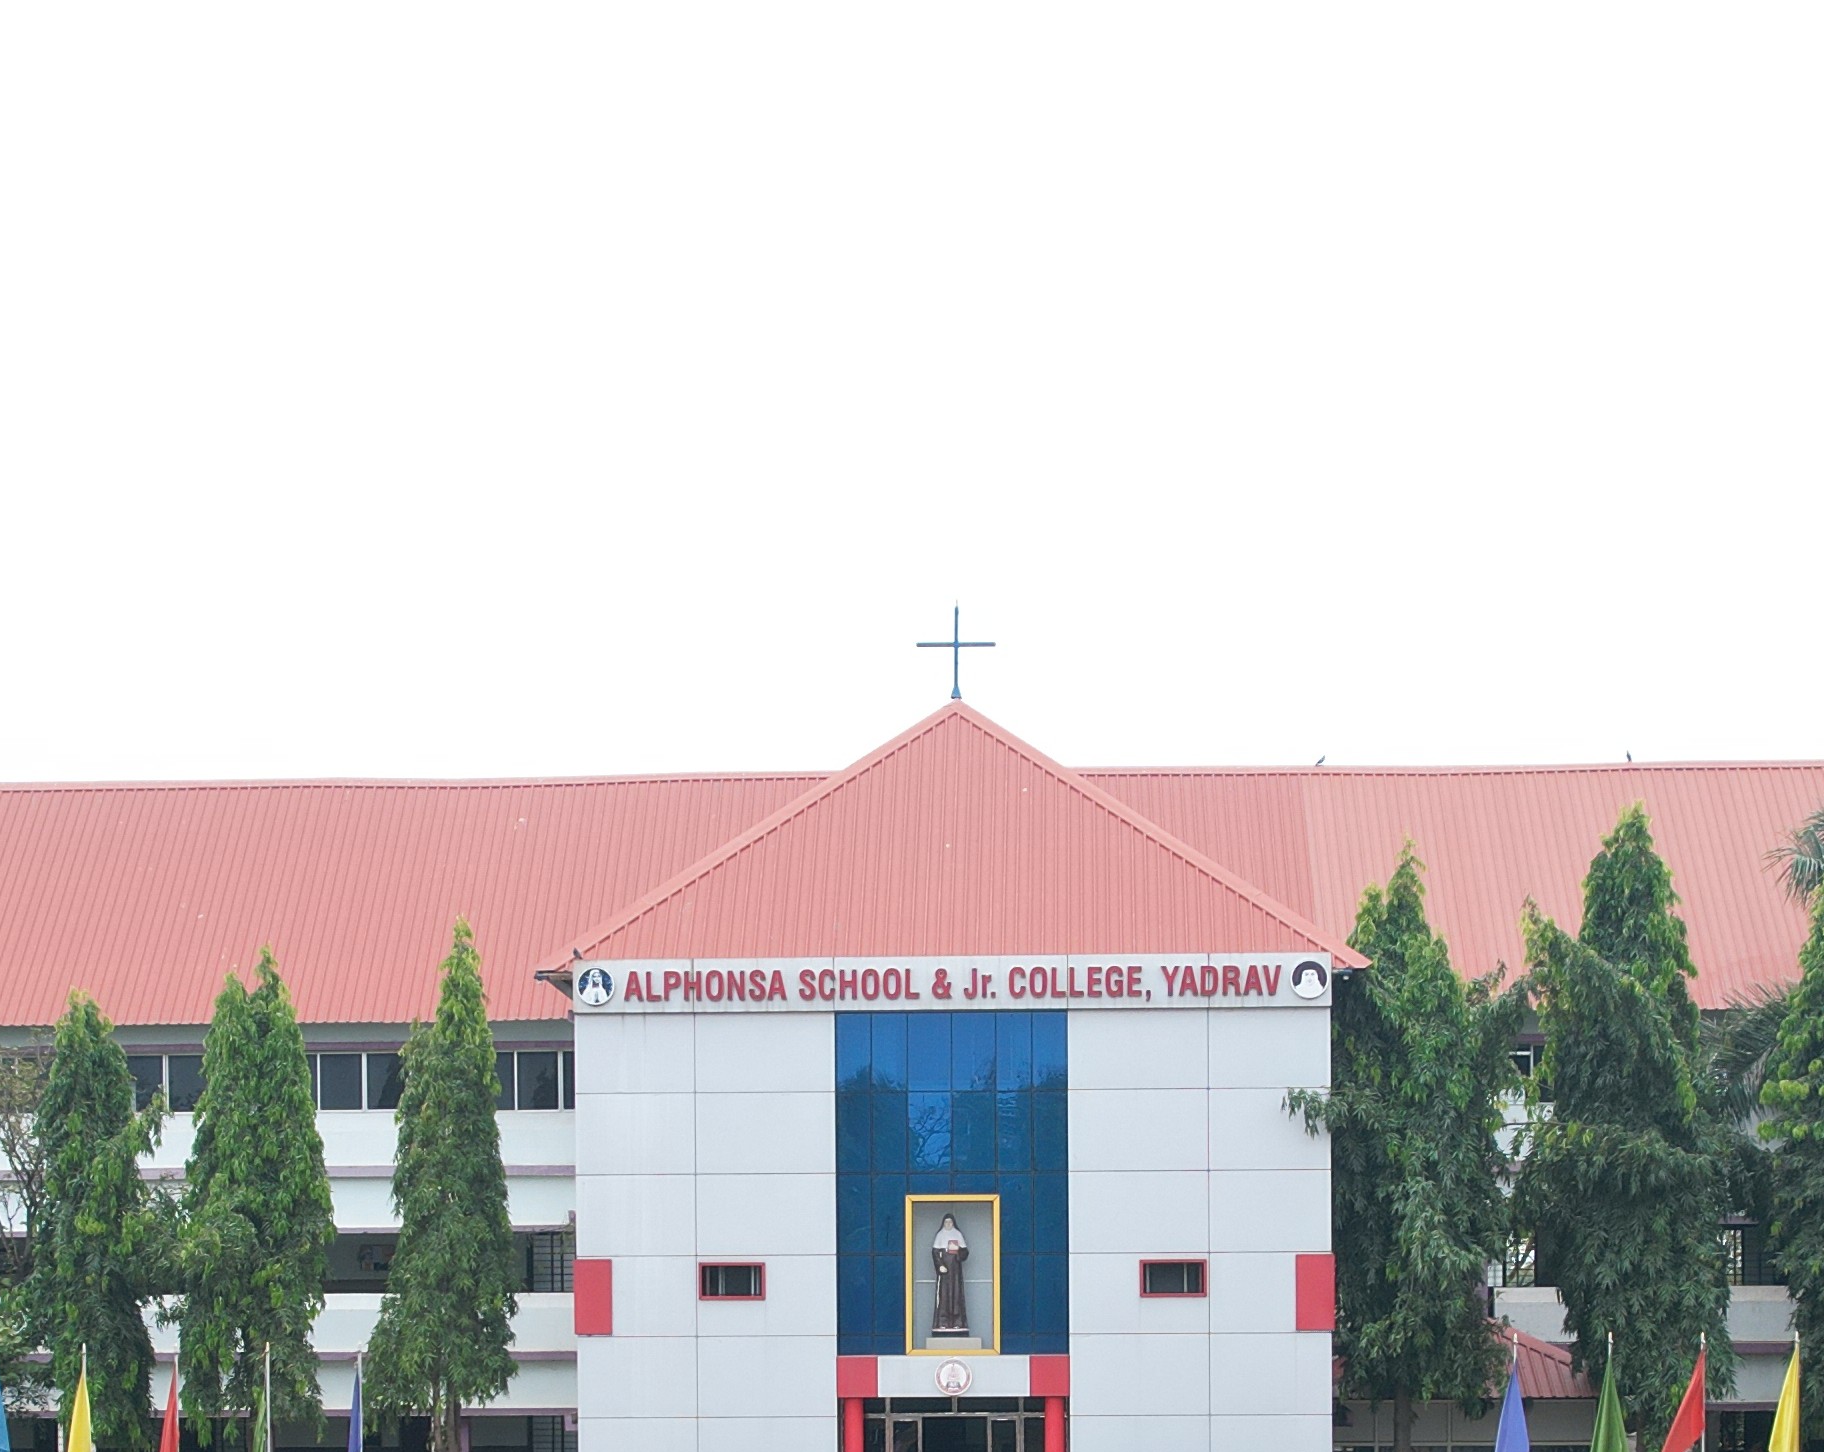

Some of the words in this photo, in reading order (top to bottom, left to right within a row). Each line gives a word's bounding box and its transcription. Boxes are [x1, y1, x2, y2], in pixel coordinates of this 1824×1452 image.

[623, 969, 786, 1001] ALPHONSA
[798, 967, 920, 1001] SCHOOL
[931, 968, 952, 998] &
[964, 967, 997, 999] Jr.
[1009, 965, 1151, 1001] COLLEGE,
[1160, 963, 1282, 996] YADRAV
